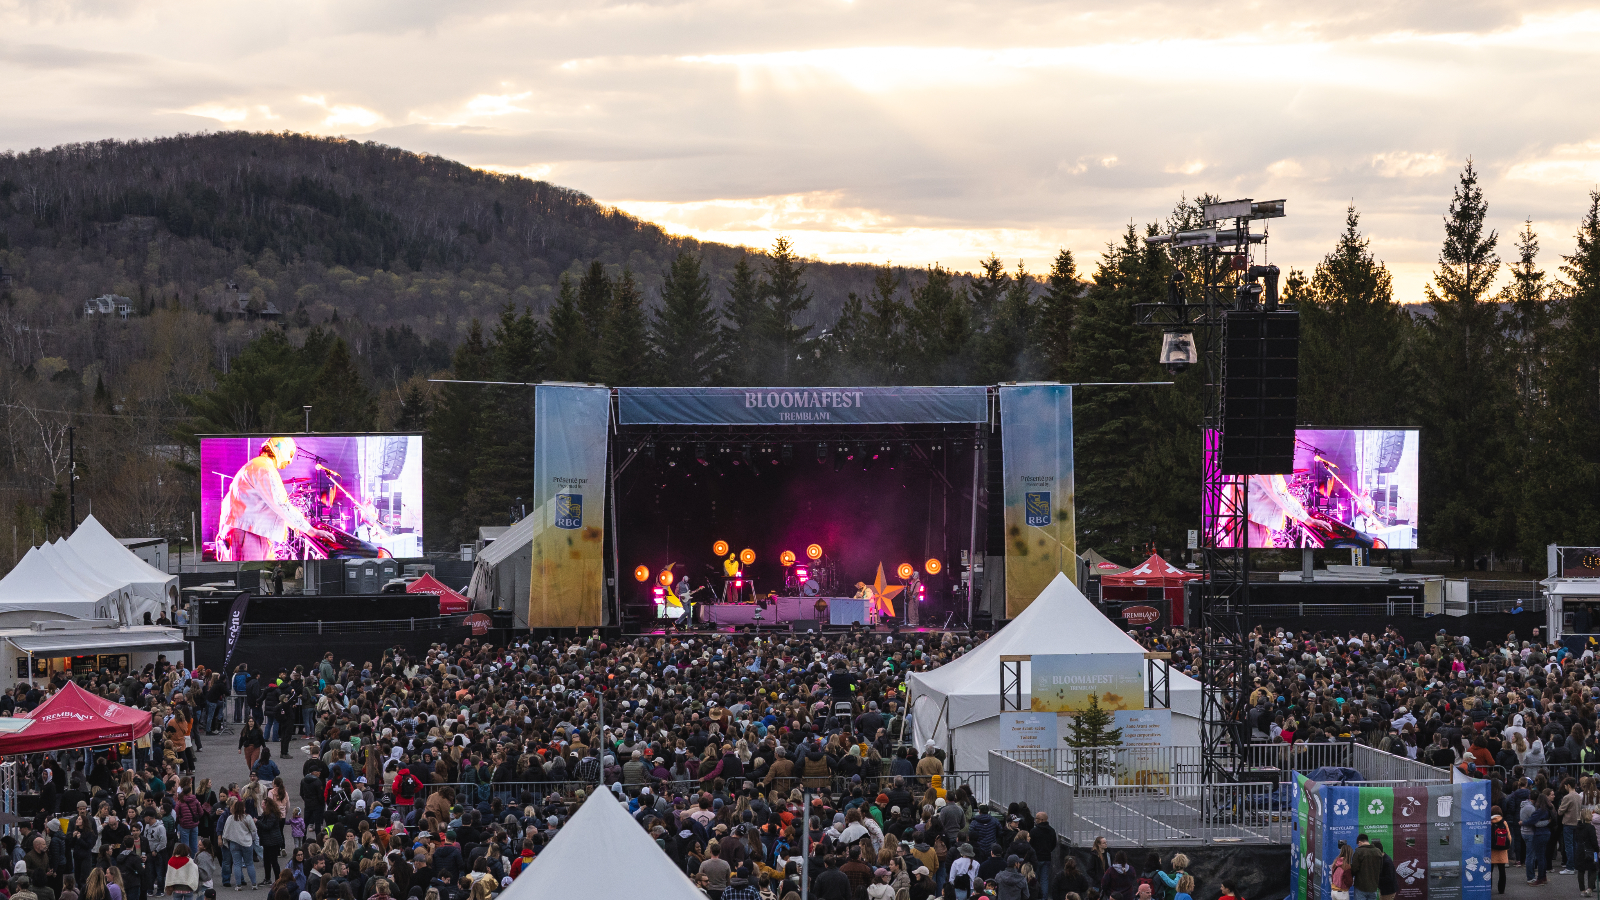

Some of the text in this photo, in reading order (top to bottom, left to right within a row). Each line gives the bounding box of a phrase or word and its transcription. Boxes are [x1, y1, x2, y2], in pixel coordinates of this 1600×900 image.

[744, 391, 864, 408] BLOOMAFEST
[778, 411, 831, 421] TREMBLANT
[558, 518, 580, 527] RBC
[1028, 515, 1049, 524] RBC
[1124, 611, 1157, 621] TREMBLANT
[1052, 674, 1114, 685] BLOOMAFEST
[42, 711, 94, 722] TREMBLANT
